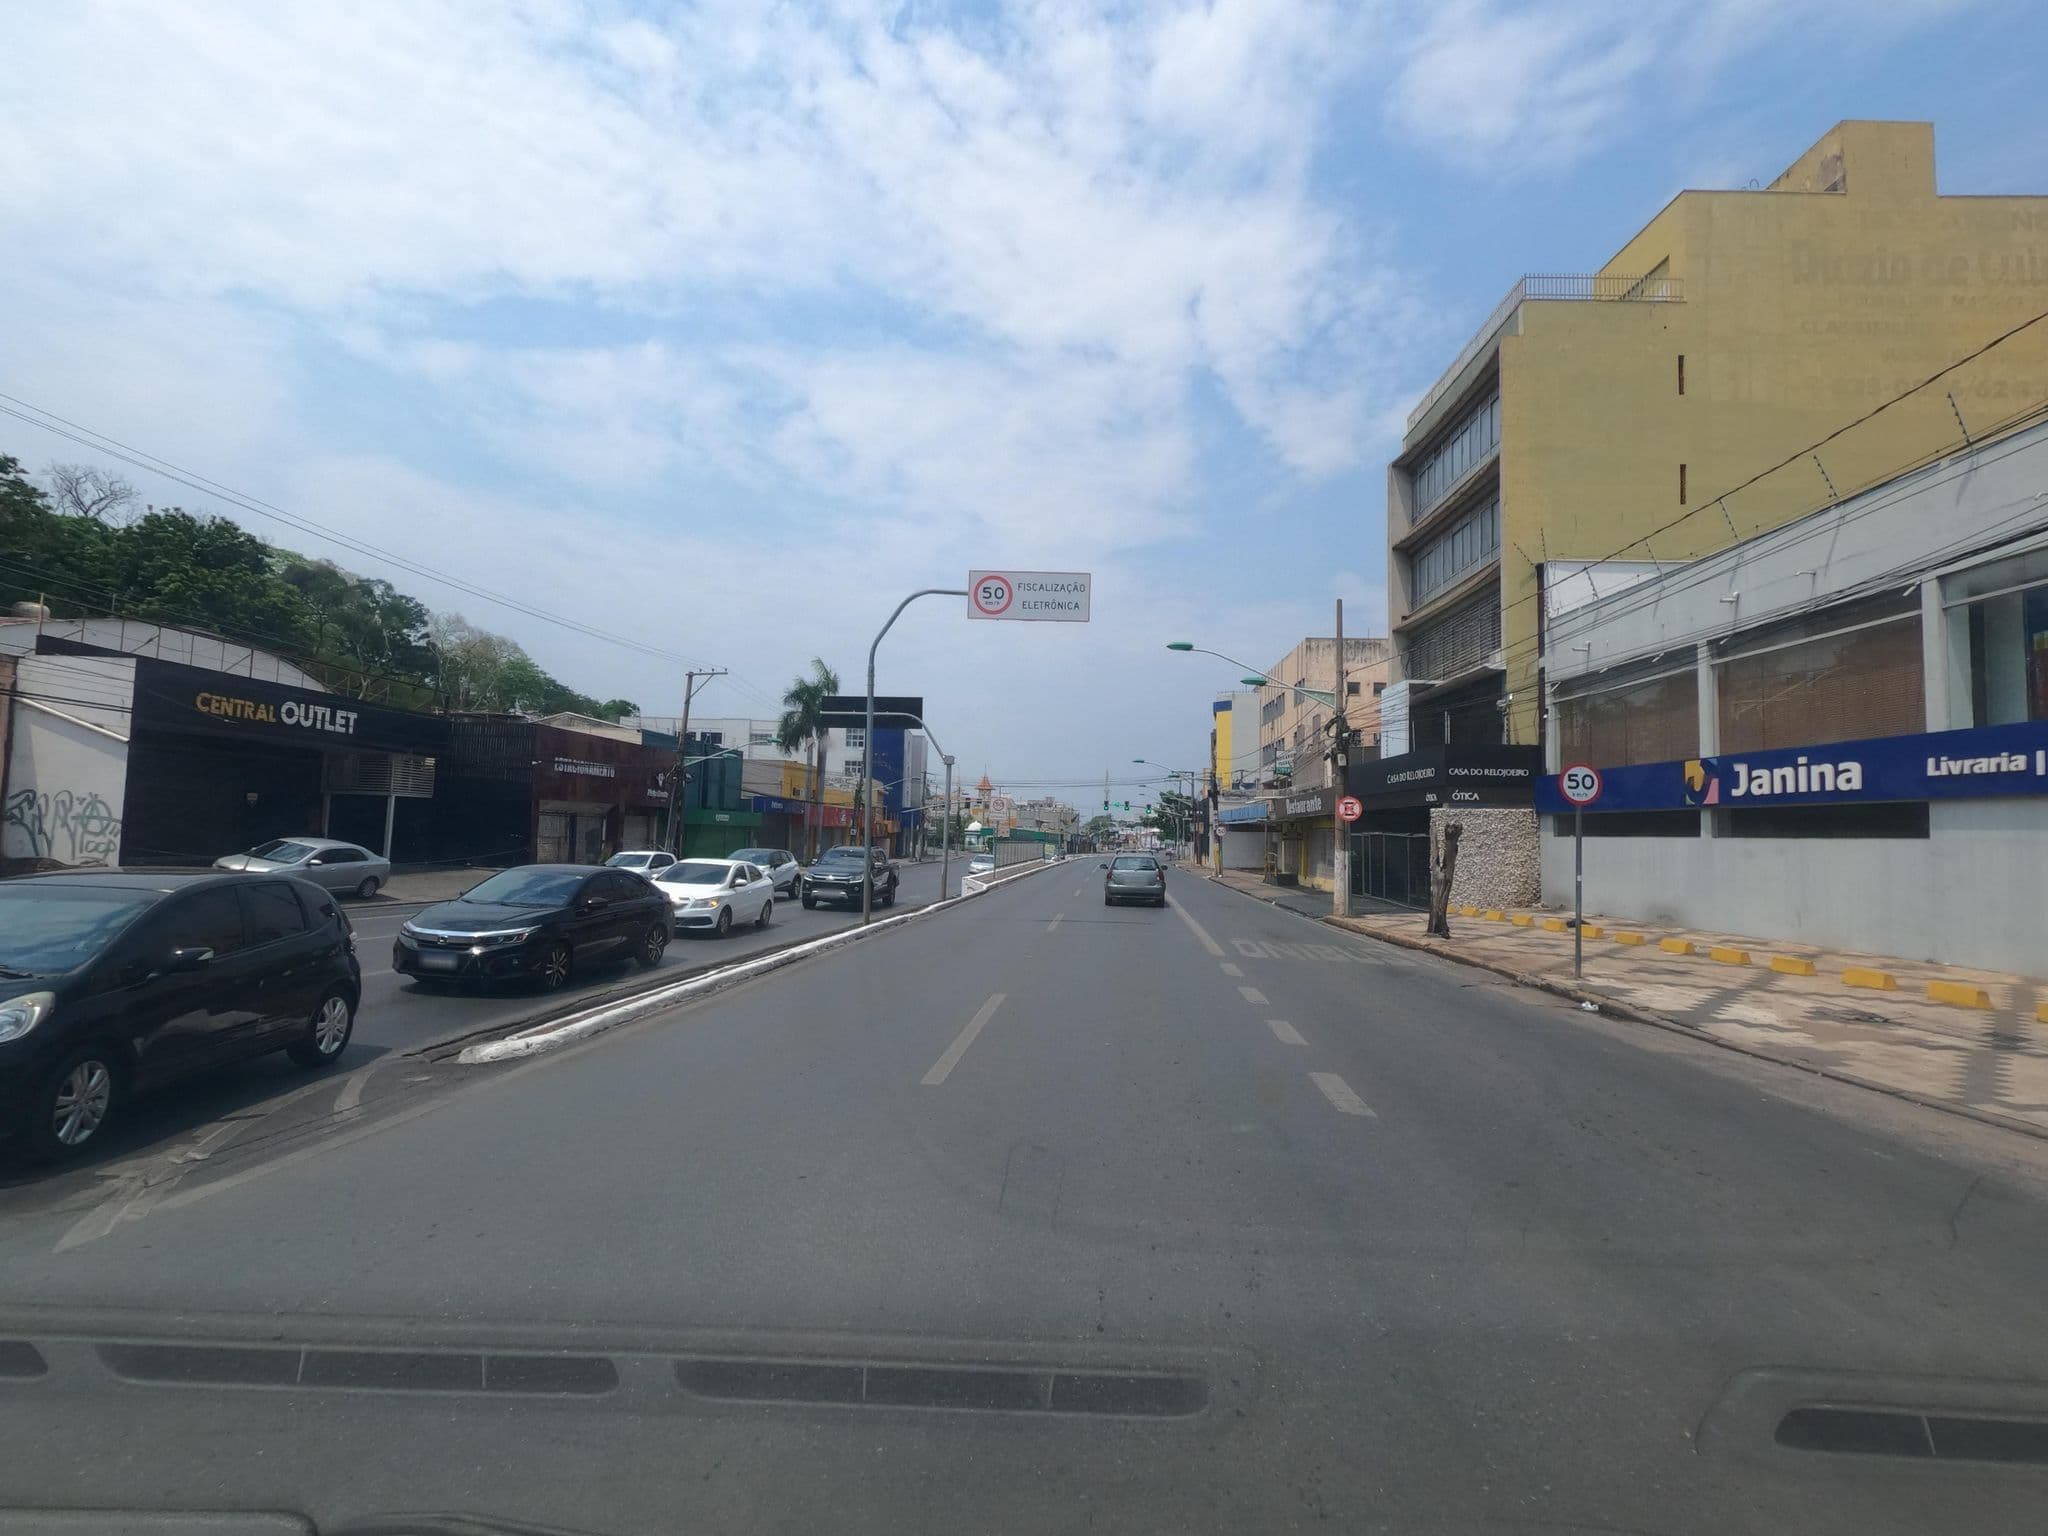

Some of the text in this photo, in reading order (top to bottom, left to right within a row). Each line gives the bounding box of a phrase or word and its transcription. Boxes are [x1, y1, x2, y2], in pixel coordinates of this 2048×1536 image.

[982, 587, 1004, 599] 50
[1017, 582, 1086, 594] FISCALIZAÇÃO
[1022, 598, 1080, 610] ELETRÔNICA
[196, 692, 358, 734] CENTRAL OUTLET
[1387, 774, 1400, 784] CASA
[1449, 768, 1530, 778] CASA DO RELOJOEIRO
[1731, 752, 2027, 797] Janina Livraria
[1567, 774, 1595, 790] 50
[1452, 789, 1480, 800] ÓTICA
